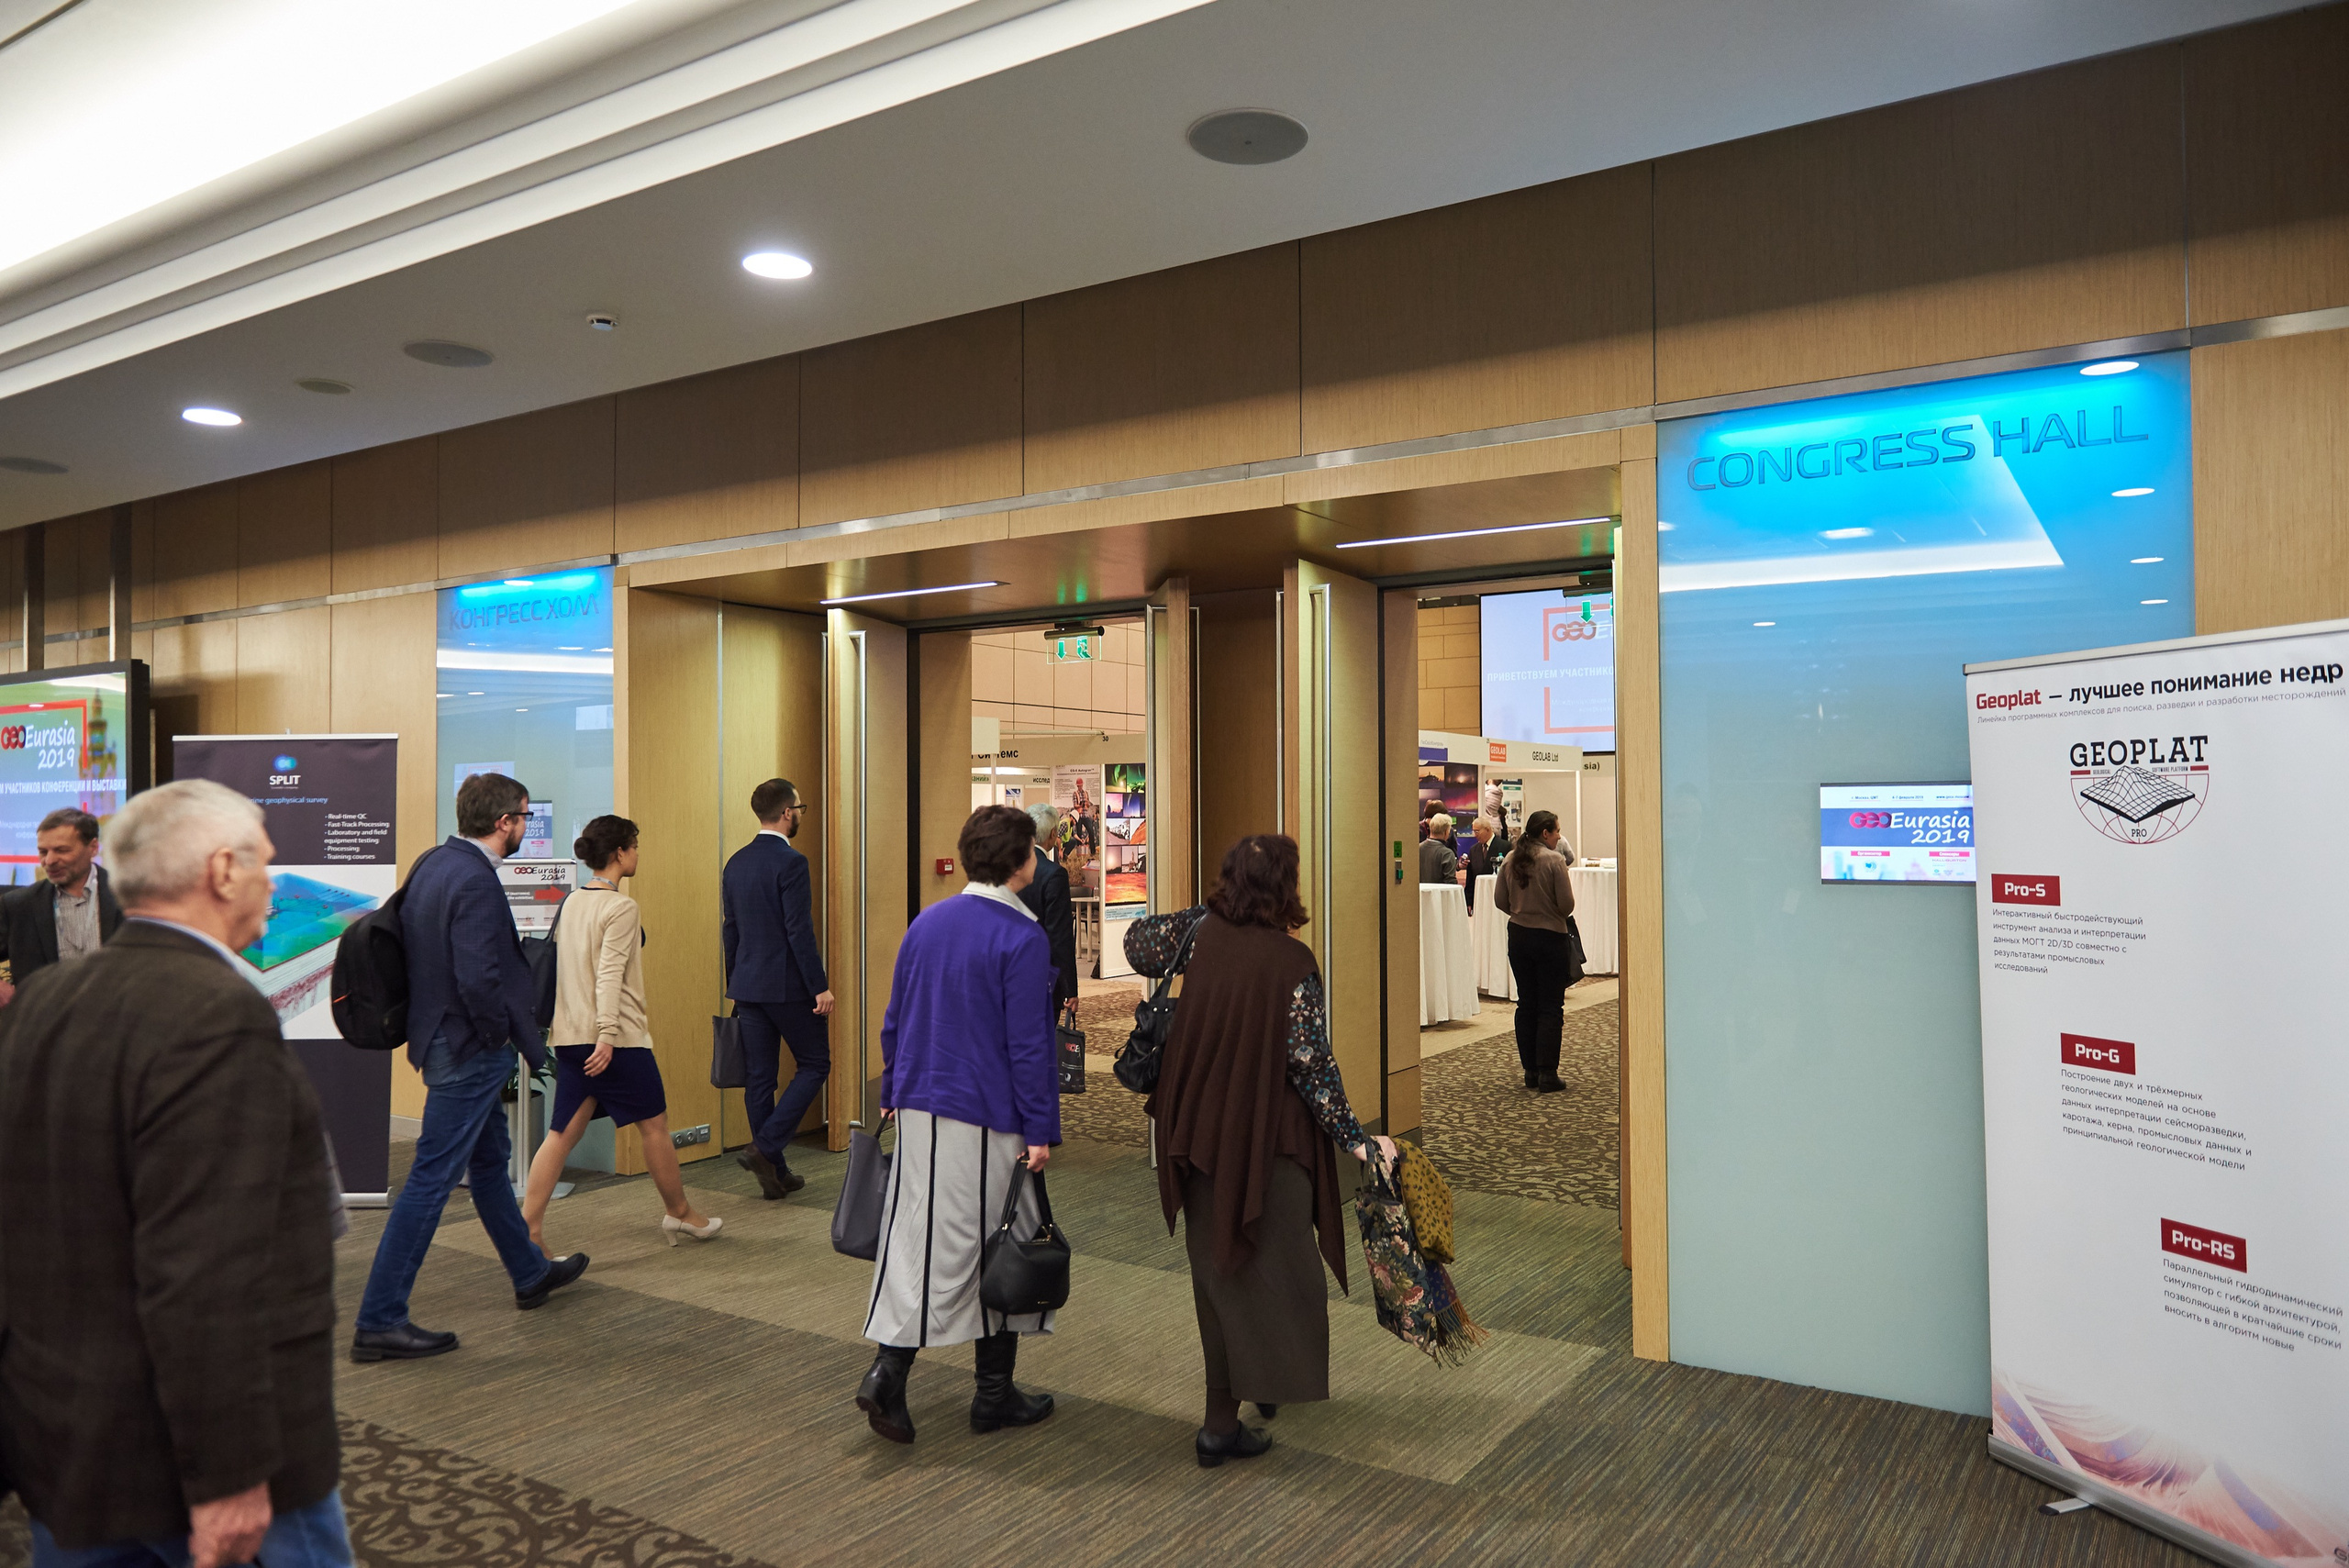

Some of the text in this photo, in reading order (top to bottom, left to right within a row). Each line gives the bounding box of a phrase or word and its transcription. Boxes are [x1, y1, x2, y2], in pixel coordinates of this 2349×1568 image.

[1687, 405, 2150, 492] CONGRESS HALL
[449, 593, 599, 630] КОНГРЕСС ХОЛЛ
[1487, 669, 1557, 682] ПРИВЕТСТВУЕМ
[1976, 688, 2042, 711] Geoplat
[2069, 679, 2144, 705] лучшее
[2150, 666, 2272, 696] понимание
[2280, 661, 2343, 684] недр
[1976, 714, 2006, 724] Линейка
[2008, 710, 2057, 721] программных
[2059, 706, 2105, 717] комплексов
[2106, 706, 2121, 715] для
[2122, 703, 2154, 712] поиска,
[2156, 698, 2196, 711] разведки
[2205, 694, 2259, 707] разработки
[2260, 687, 2347, 703] месторождений
[38, 749, 75, 771] 2019
[1490, 746, 1506, 755] GEOLAB
[1532, 751, 1551, 762] GEOLAB
[2069, 735, 2208, 767] GEOPLAT
[5, 782, 40, 795] УЧАСТНИКОВ
[41, 780, 86, 794] КОНФЕРЕНЦИИ
[86, 780, 91, 791] И
[92, 779, 127, 791] ВЫСТАВКИ
[269, 775, 301, 785] SPLIT
[264, 796, 305, 806] geophysical
[525, 828, 545, 837] 2019
[1910, 828, 1970, 844] 2019
[2132, 828, 2147, 838] PRO
[2004, 882, 2046, 897] Pro-S
[1992, 907, 2143, 926] Интерактивный быстродействующий
[1992, 923, 2037, 933] инструмент
[2038, 926, 2072, 935] анализа
[2081, 928, 2146, 940] интерпретации
[1993, 936, 2021, 945] данных
[2021, 937, 2045, 947] МОГТ
[2047, 939, 2074, 950] 2D/3D
[2075, 942, 2120, 953] совместно
[1994, 949, 2105, 965] результатами промысловых
[1994, 962, 2048, 974] исследований
[2075, 1043, 2120, 1063] Pro-G
[2061, 1069, 2111, 1085] Построение
[2113, 1078, 2134, 1089] двух
[2145, 1084, 2203, 1101] трёхмерных
[2061, 1084, 2217, 1118] геологических моделей на основе
[2062, 1098, 2246, 1141] данных интерпретации сейсморазведки,
[2062, 1112, 2252, 1157] каротажа, керна, промысловых данных и
[2063, 1125, 2245, 1171] принципиальной геологической модели
[2172, 1229, 2235, 1261] Pro-RS
[2163, 1258, 2343, 1317] Параллельный гидродинамический
[2163, 1274, 2214, 1297] симулятор
[2224, 1292, 2260, 1309] гибкой
[2263, 1303, 2341, 1334] архитектурой,
[2164, 1289, 2231, 1316] позволяющей
[2242, 1314, 2304, 1339] кратчайшие
[2308, 1334, 2342, 1351] сроки
[2165, 1305, 2295, 1351] вносить в алгоритм новые
